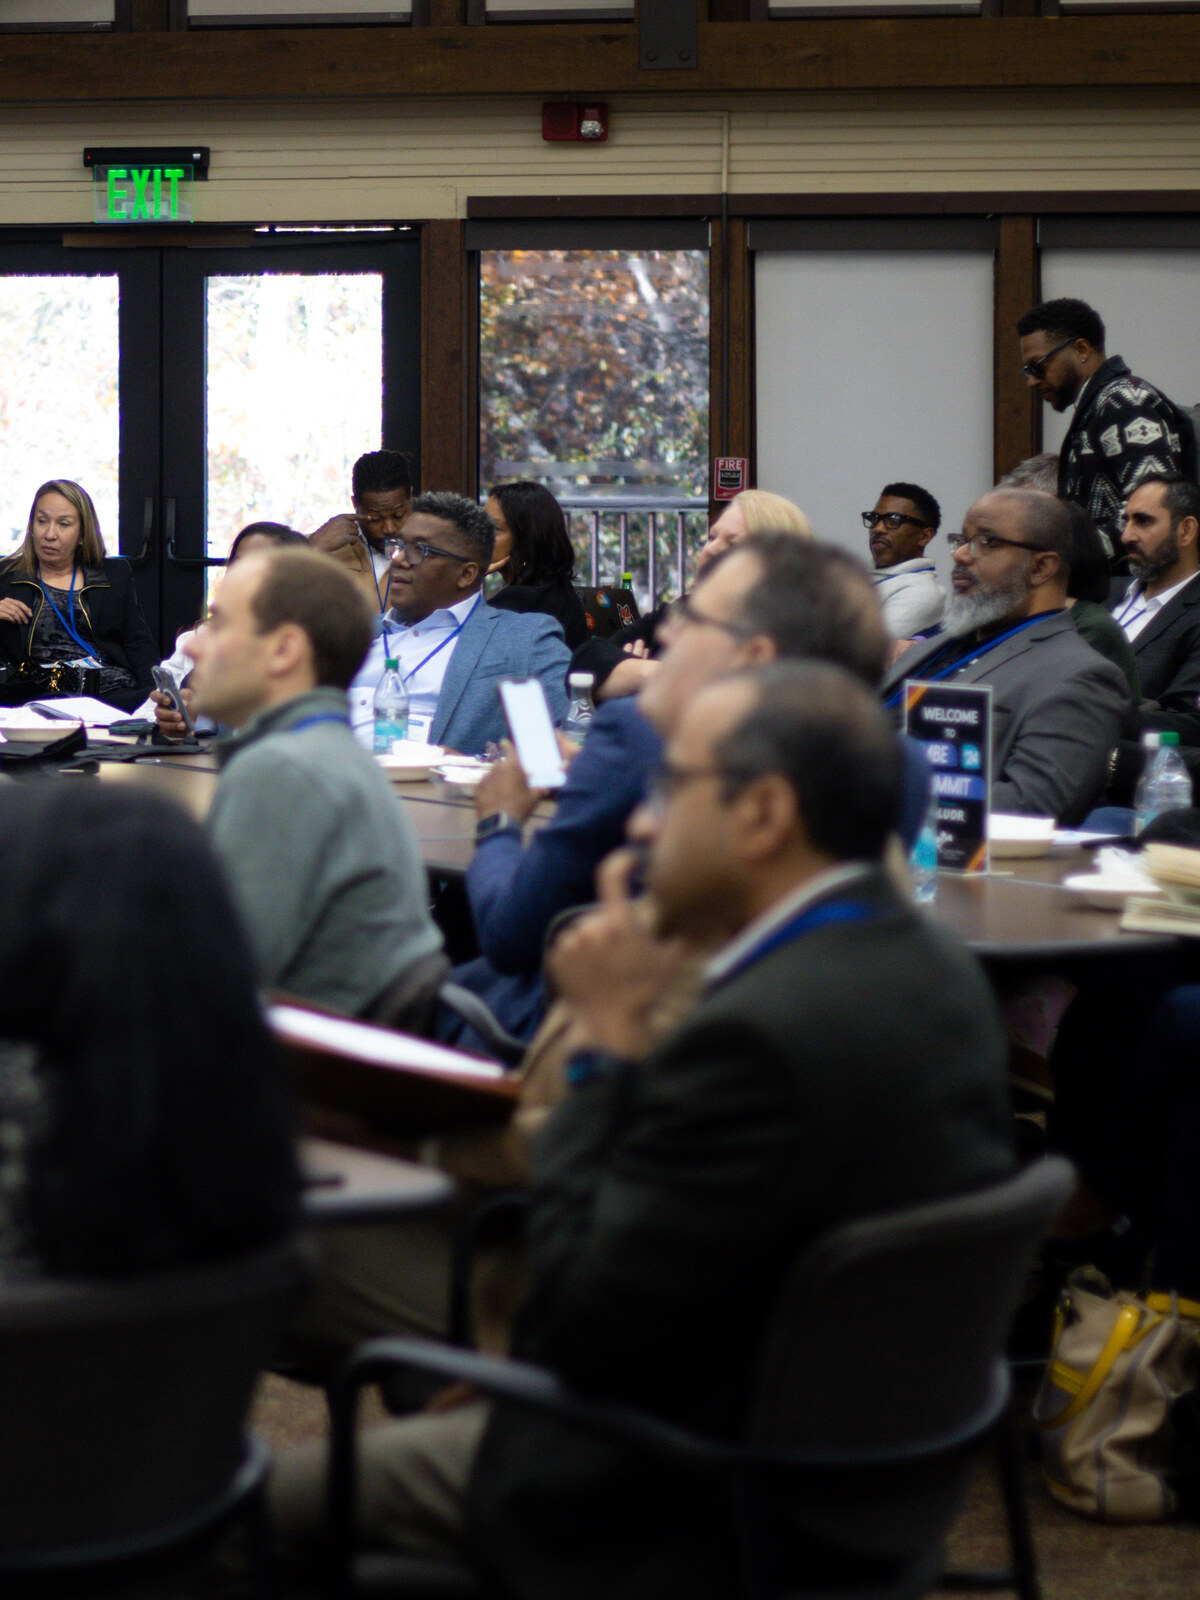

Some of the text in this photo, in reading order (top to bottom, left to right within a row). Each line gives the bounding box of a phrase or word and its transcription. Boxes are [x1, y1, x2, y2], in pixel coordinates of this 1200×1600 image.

[107, 169, 184, 219] EXIT
[719, 459, 742, 469] FIRE
[923, 706, 979, 724] WELCOME
[945, 727, 956, 738] TO
[933, 775, 972, 796] MMIT
[938, 807, 966, 823] LUOR
